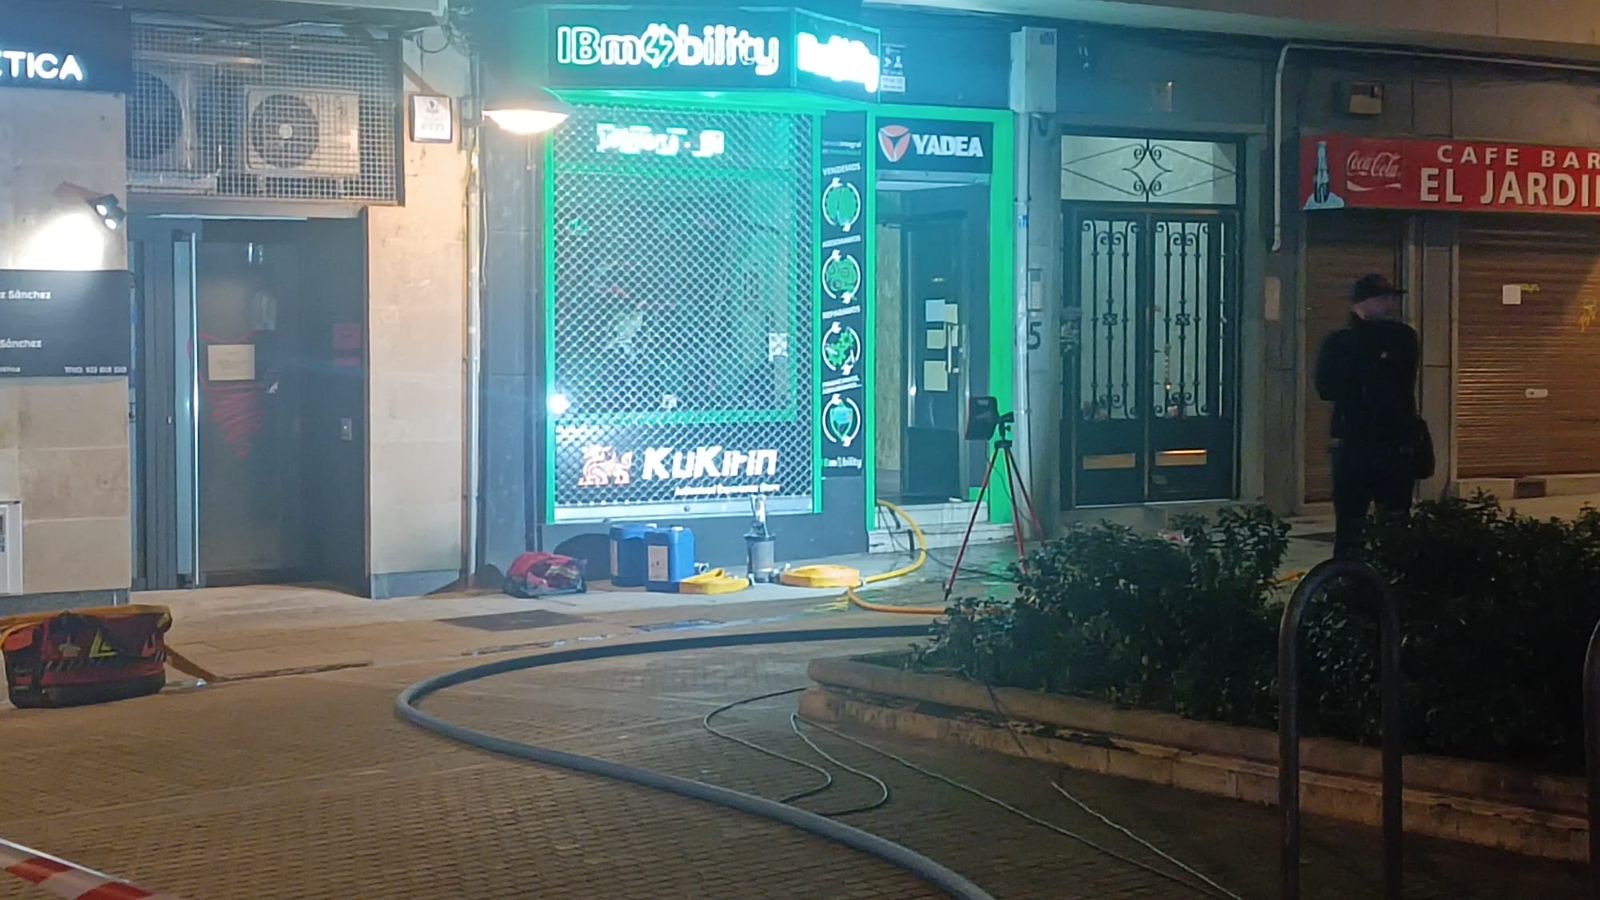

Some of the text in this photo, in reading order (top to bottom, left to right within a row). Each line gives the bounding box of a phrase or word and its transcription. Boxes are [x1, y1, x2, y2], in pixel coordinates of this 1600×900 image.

[0, 50, 83, 81] TICA
[911, 133, 984, 157] YADEA
[1437, 144, 1600, 169] CAFE BAR
[1420, 167, 1600, 208] EL JARDI
